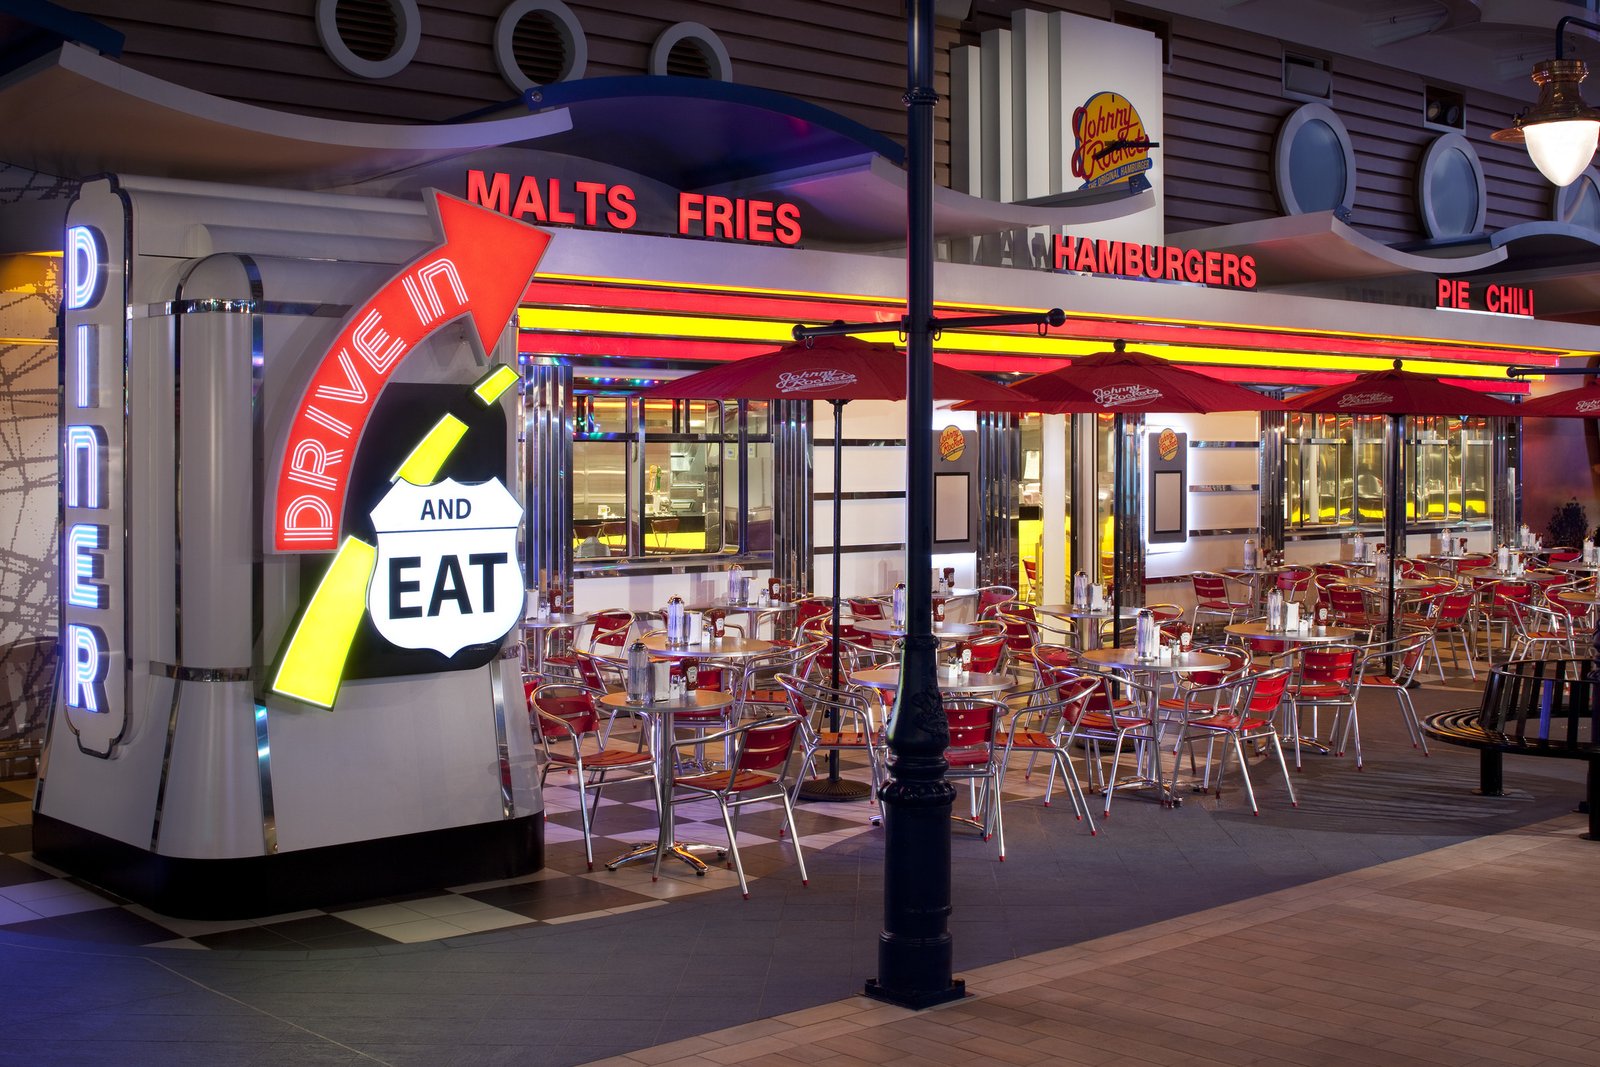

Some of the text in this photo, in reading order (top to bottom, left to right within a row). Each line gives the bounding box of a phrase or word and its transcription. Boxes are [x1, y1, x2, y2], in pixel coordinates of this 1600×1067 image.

[1071, 105, 1139, 178] Johnny
[467, 169, 802, 245] MALTS FRIES
[1053, 233, 1257, 289] HAMBURGERS
[1436, 279, 1470, 310] PIE
[1486, 284, 1534, 316] CHILI
[284, 257, 469, 542] DRIVE IN
[776, 369, 838, 389] Johnny
[791, 373, 856, 388] Rockets
[1093, 384, 1147, 404] Johnny
[1104, 388, 1159, 404] Rockets
[68, 225, 107, 713] DINER
[420, 498, 471, 521] AND
[388, 552, 508, 620] EAT
